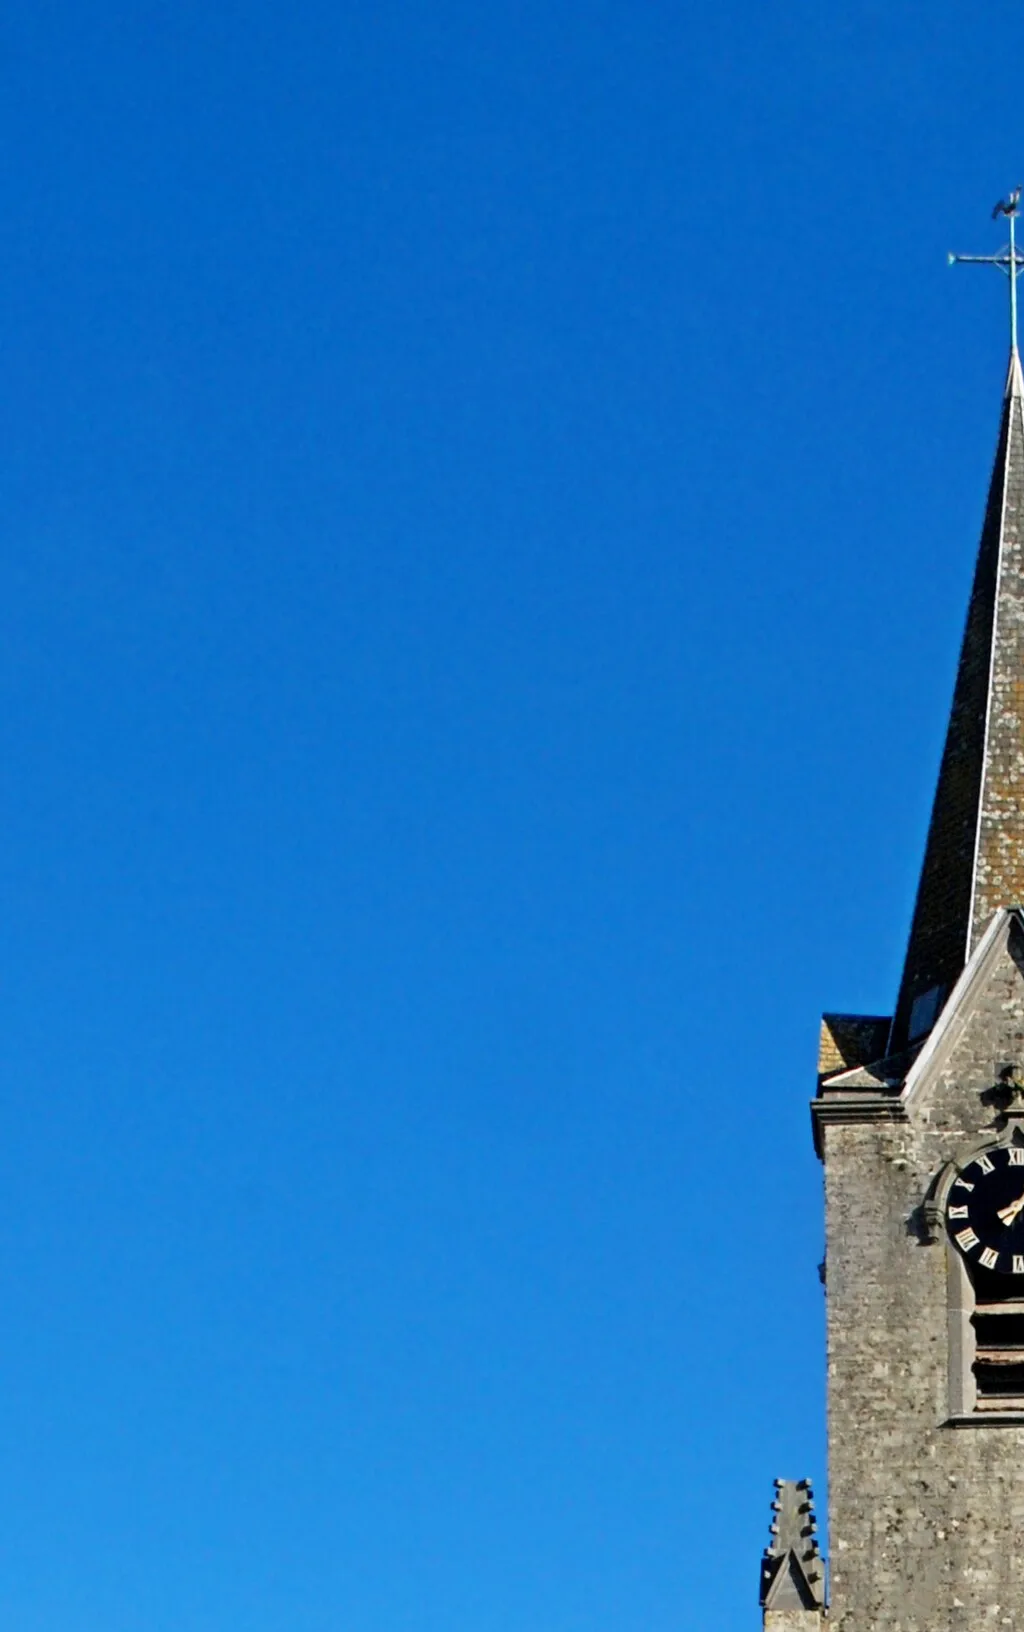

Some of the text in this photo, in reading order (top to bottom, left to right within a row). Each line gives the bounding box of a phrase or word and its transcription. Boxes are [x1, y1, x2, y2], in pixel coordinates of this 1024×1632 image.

[976, 1154, 996, 1175] XI
[954, 1177, 975, 1192] X
[948, 1205, 969, 1219] IX
[954, 1227, 980, 1252] VIII
[978, 1246, 999, 1270] VII
